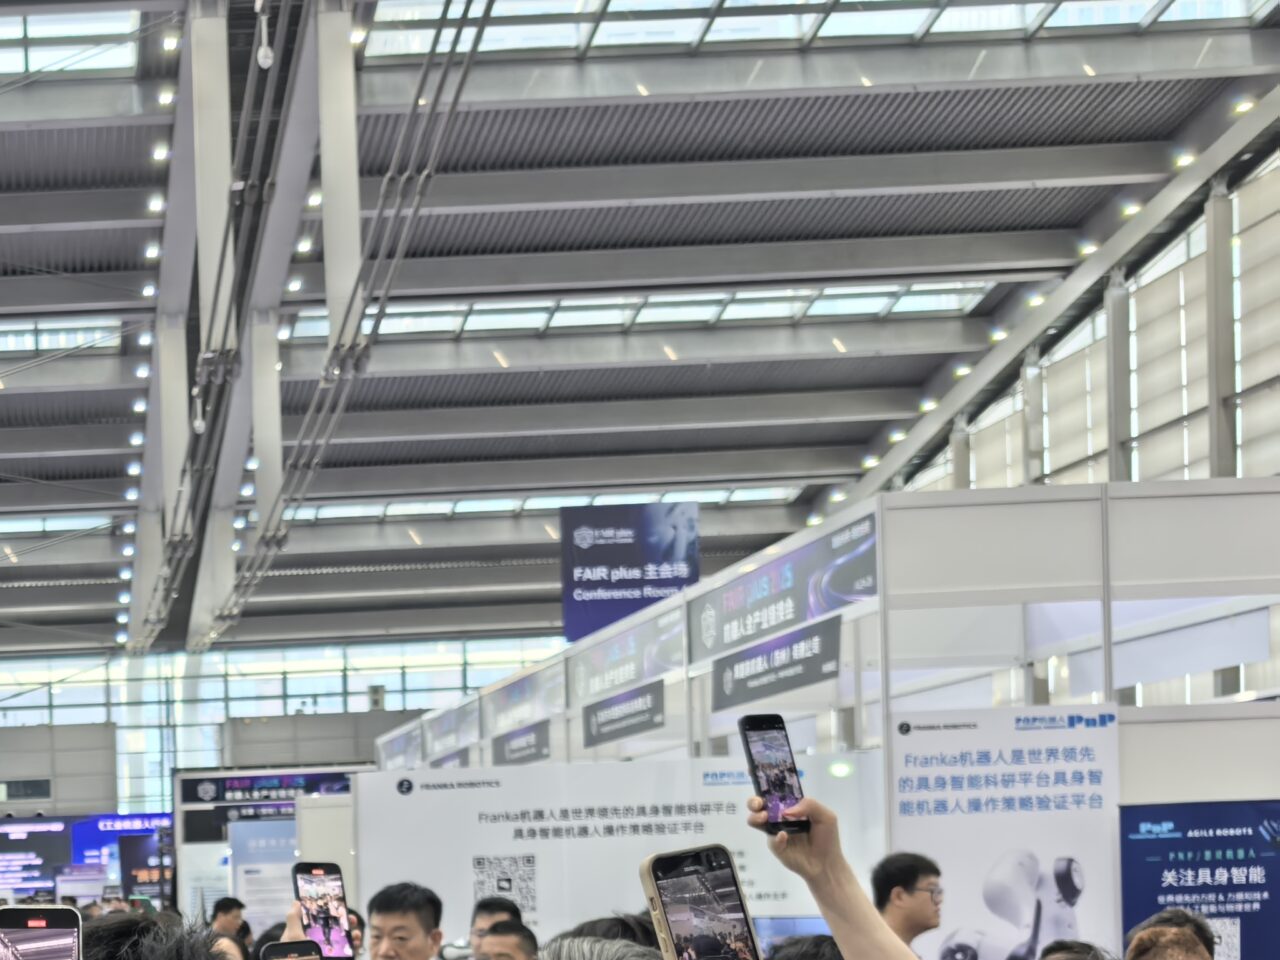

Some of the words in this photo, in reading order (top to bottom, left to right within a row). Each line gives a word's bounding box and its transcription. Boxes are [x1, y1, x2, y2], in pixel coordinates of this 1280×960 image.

[573, 566, 610, 582] FAIR
[610, 566, 642, 583] plus
[643, 562, 690, 580] 主会场
[573, 587, 642, 601] Conference
[904, 745, 1096, 768] Franka机器人是世界领先
[898, 769, 1104, 794] 的具身智能科研平台具身智
[477, 802, 737, 824] Franka机器人是世界领先的具身智能科研平台
[898, 793, 1104, 817] 能机器人操作策略验证平台
[1186, 828, 1214, 838] AGILE
[1215, 826, 1254, 837] ROBOTS
[1161, 864, 1267, 888] 关注具身智能
